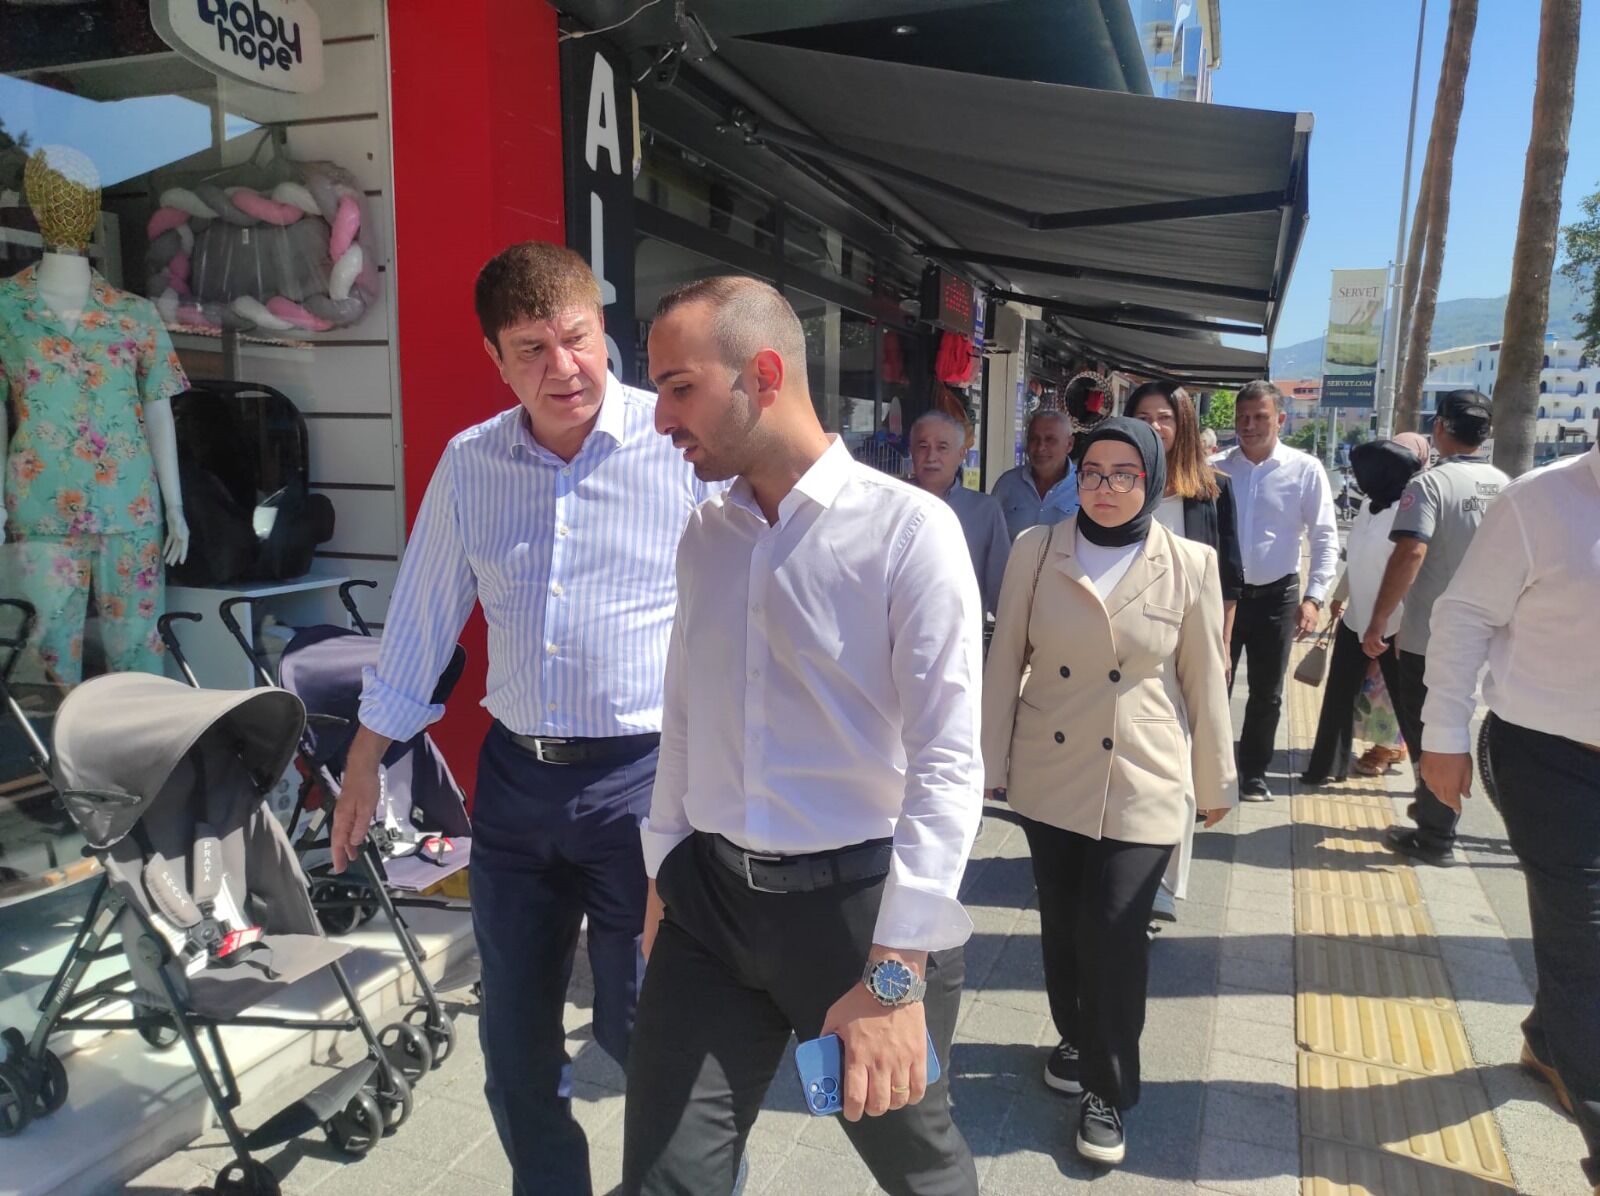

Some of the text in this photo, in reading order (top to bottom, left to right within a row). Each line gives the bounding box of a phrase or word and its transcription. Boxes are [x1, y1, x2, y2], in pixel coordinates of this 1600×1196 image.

[217, 18, 293, 71] hope
[1338, 286, 1380, 298] SERVET
[203, 841, 212, 882] PRAVA
